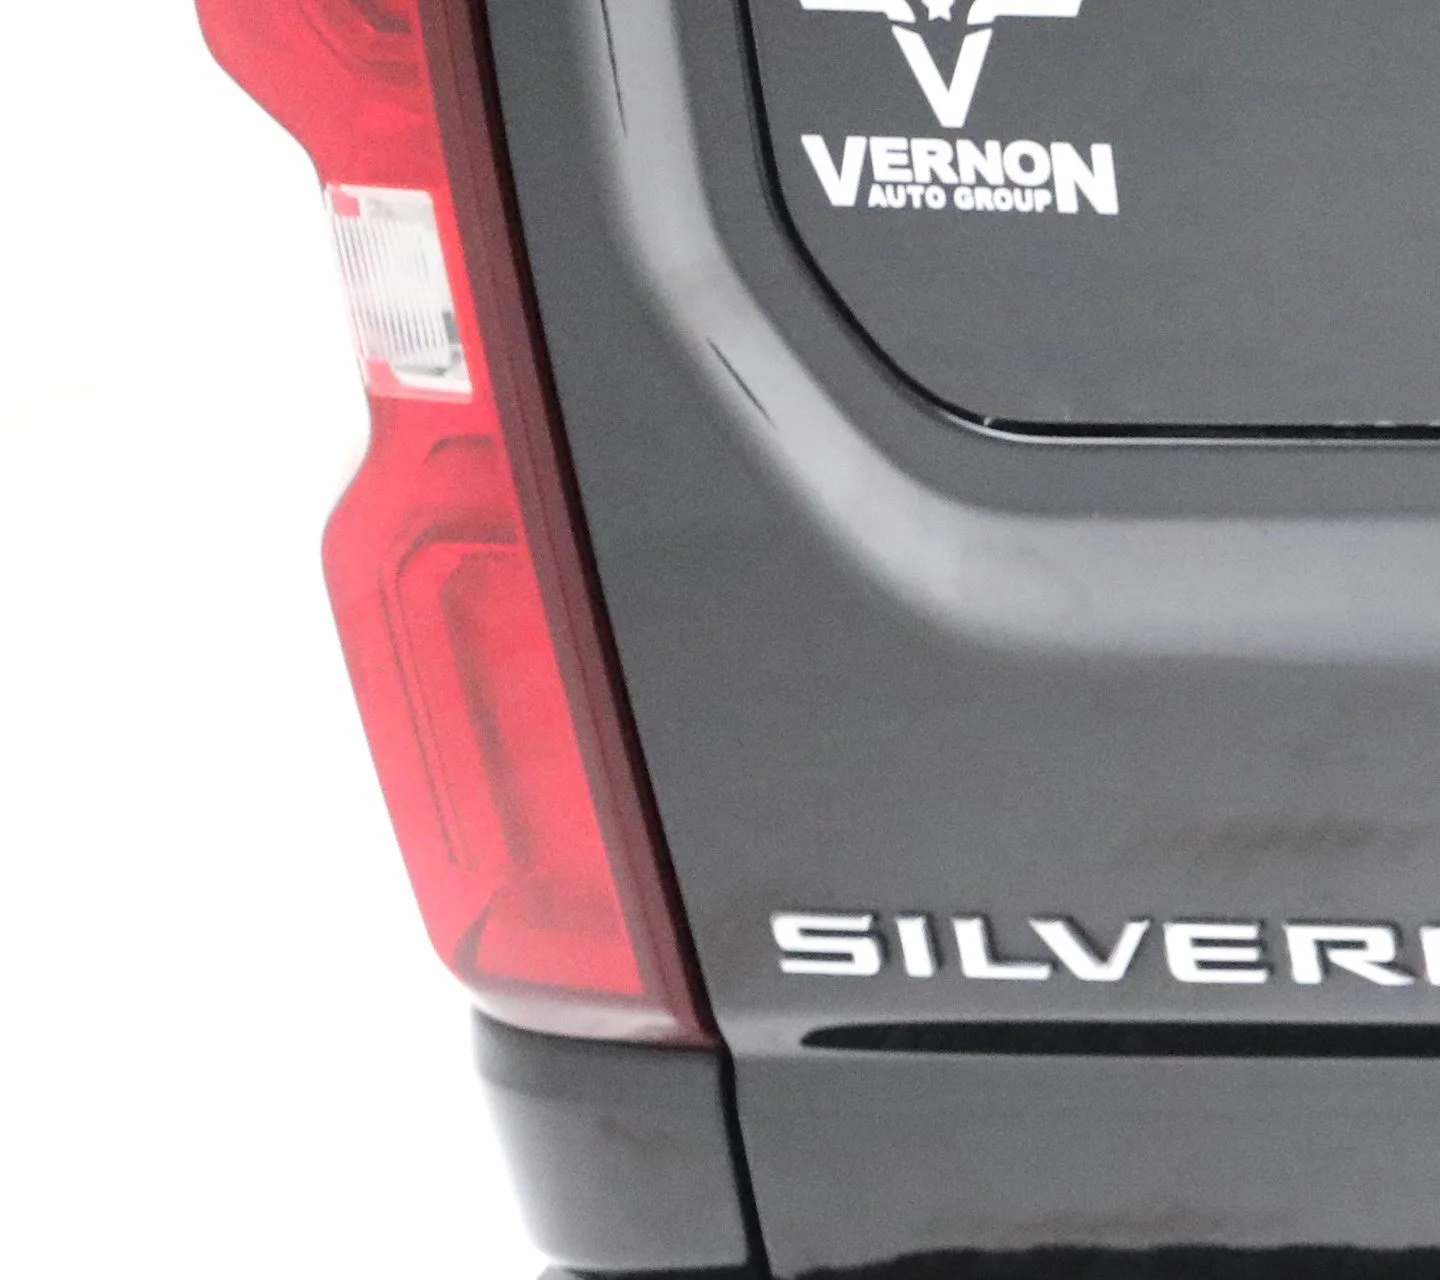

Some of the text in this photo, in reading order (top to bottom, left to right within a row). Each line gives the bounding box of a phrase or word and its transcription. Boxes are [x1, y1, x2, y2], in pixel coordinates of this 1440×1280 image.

[801, 134, 1119, 215] VERNON
[868, 183, 1053, 213] AUTO GROUP
